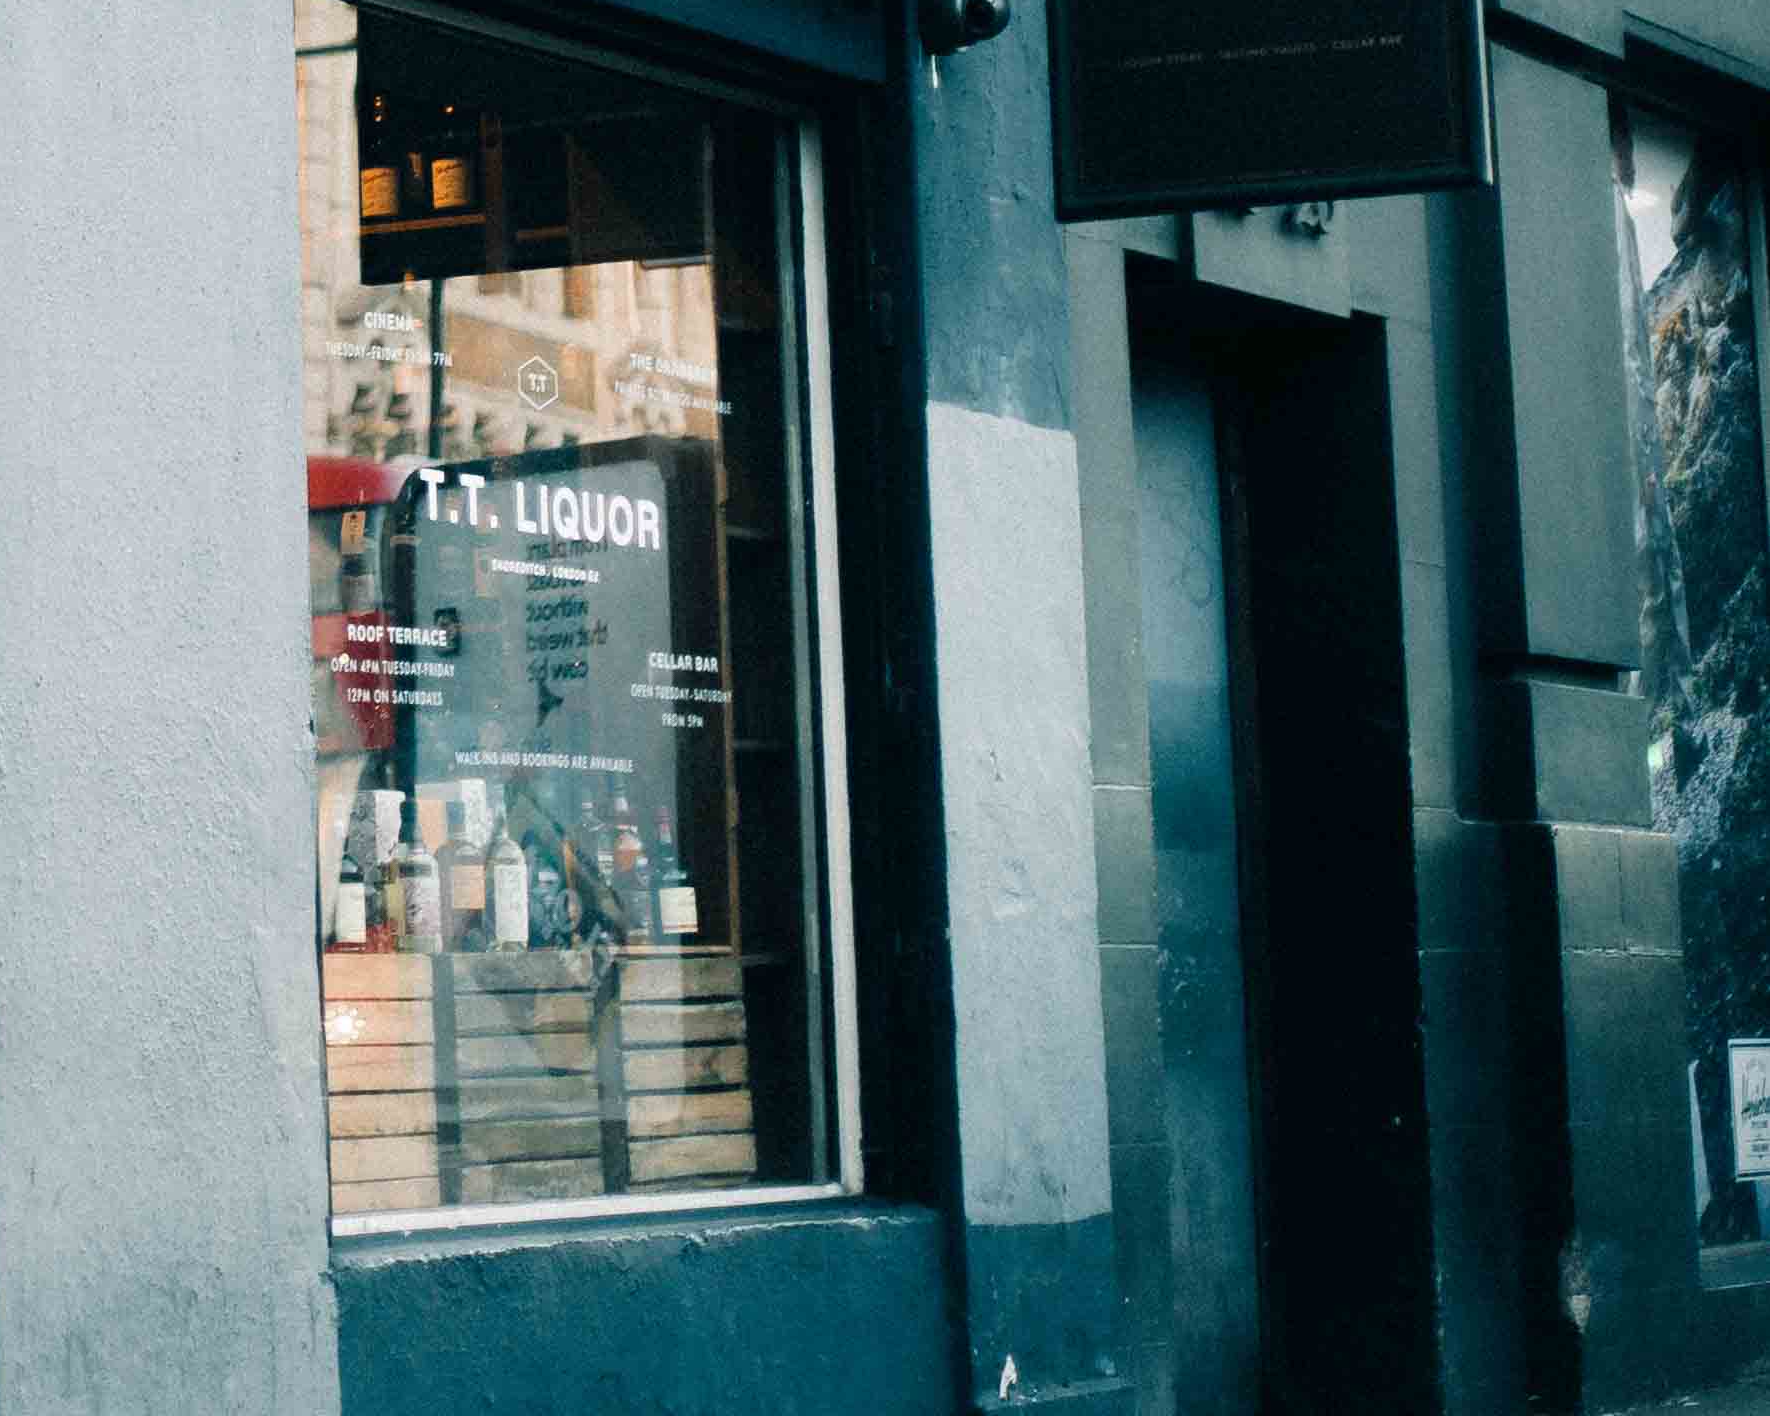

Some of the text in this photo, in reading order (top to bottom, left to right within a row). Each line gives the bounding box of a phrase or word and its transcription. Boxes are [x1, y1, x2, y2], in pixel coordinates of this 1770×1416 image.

[364, 311, 414, 331] CINEMA
[420, 468, 660, 550] T.T. LIQUOR
[347, 624, 447, 647] ROOF TERRACE
[330, 657, 455, 678] OPEN 4PM TUESDAY-FRIDAY
[649, 652, 718, 673] CELLAR BAR
[347, 687, 444, 706] 12PM ON SATURDAYS
[630, 683, 654, 698] OPEN
[500, 752, 519, 767] AND
[522, 752, 570, 768] BOOKINGS
[571, 755, 588, 769] ARE
[589, 756, 634, 773] AVAILABLE
